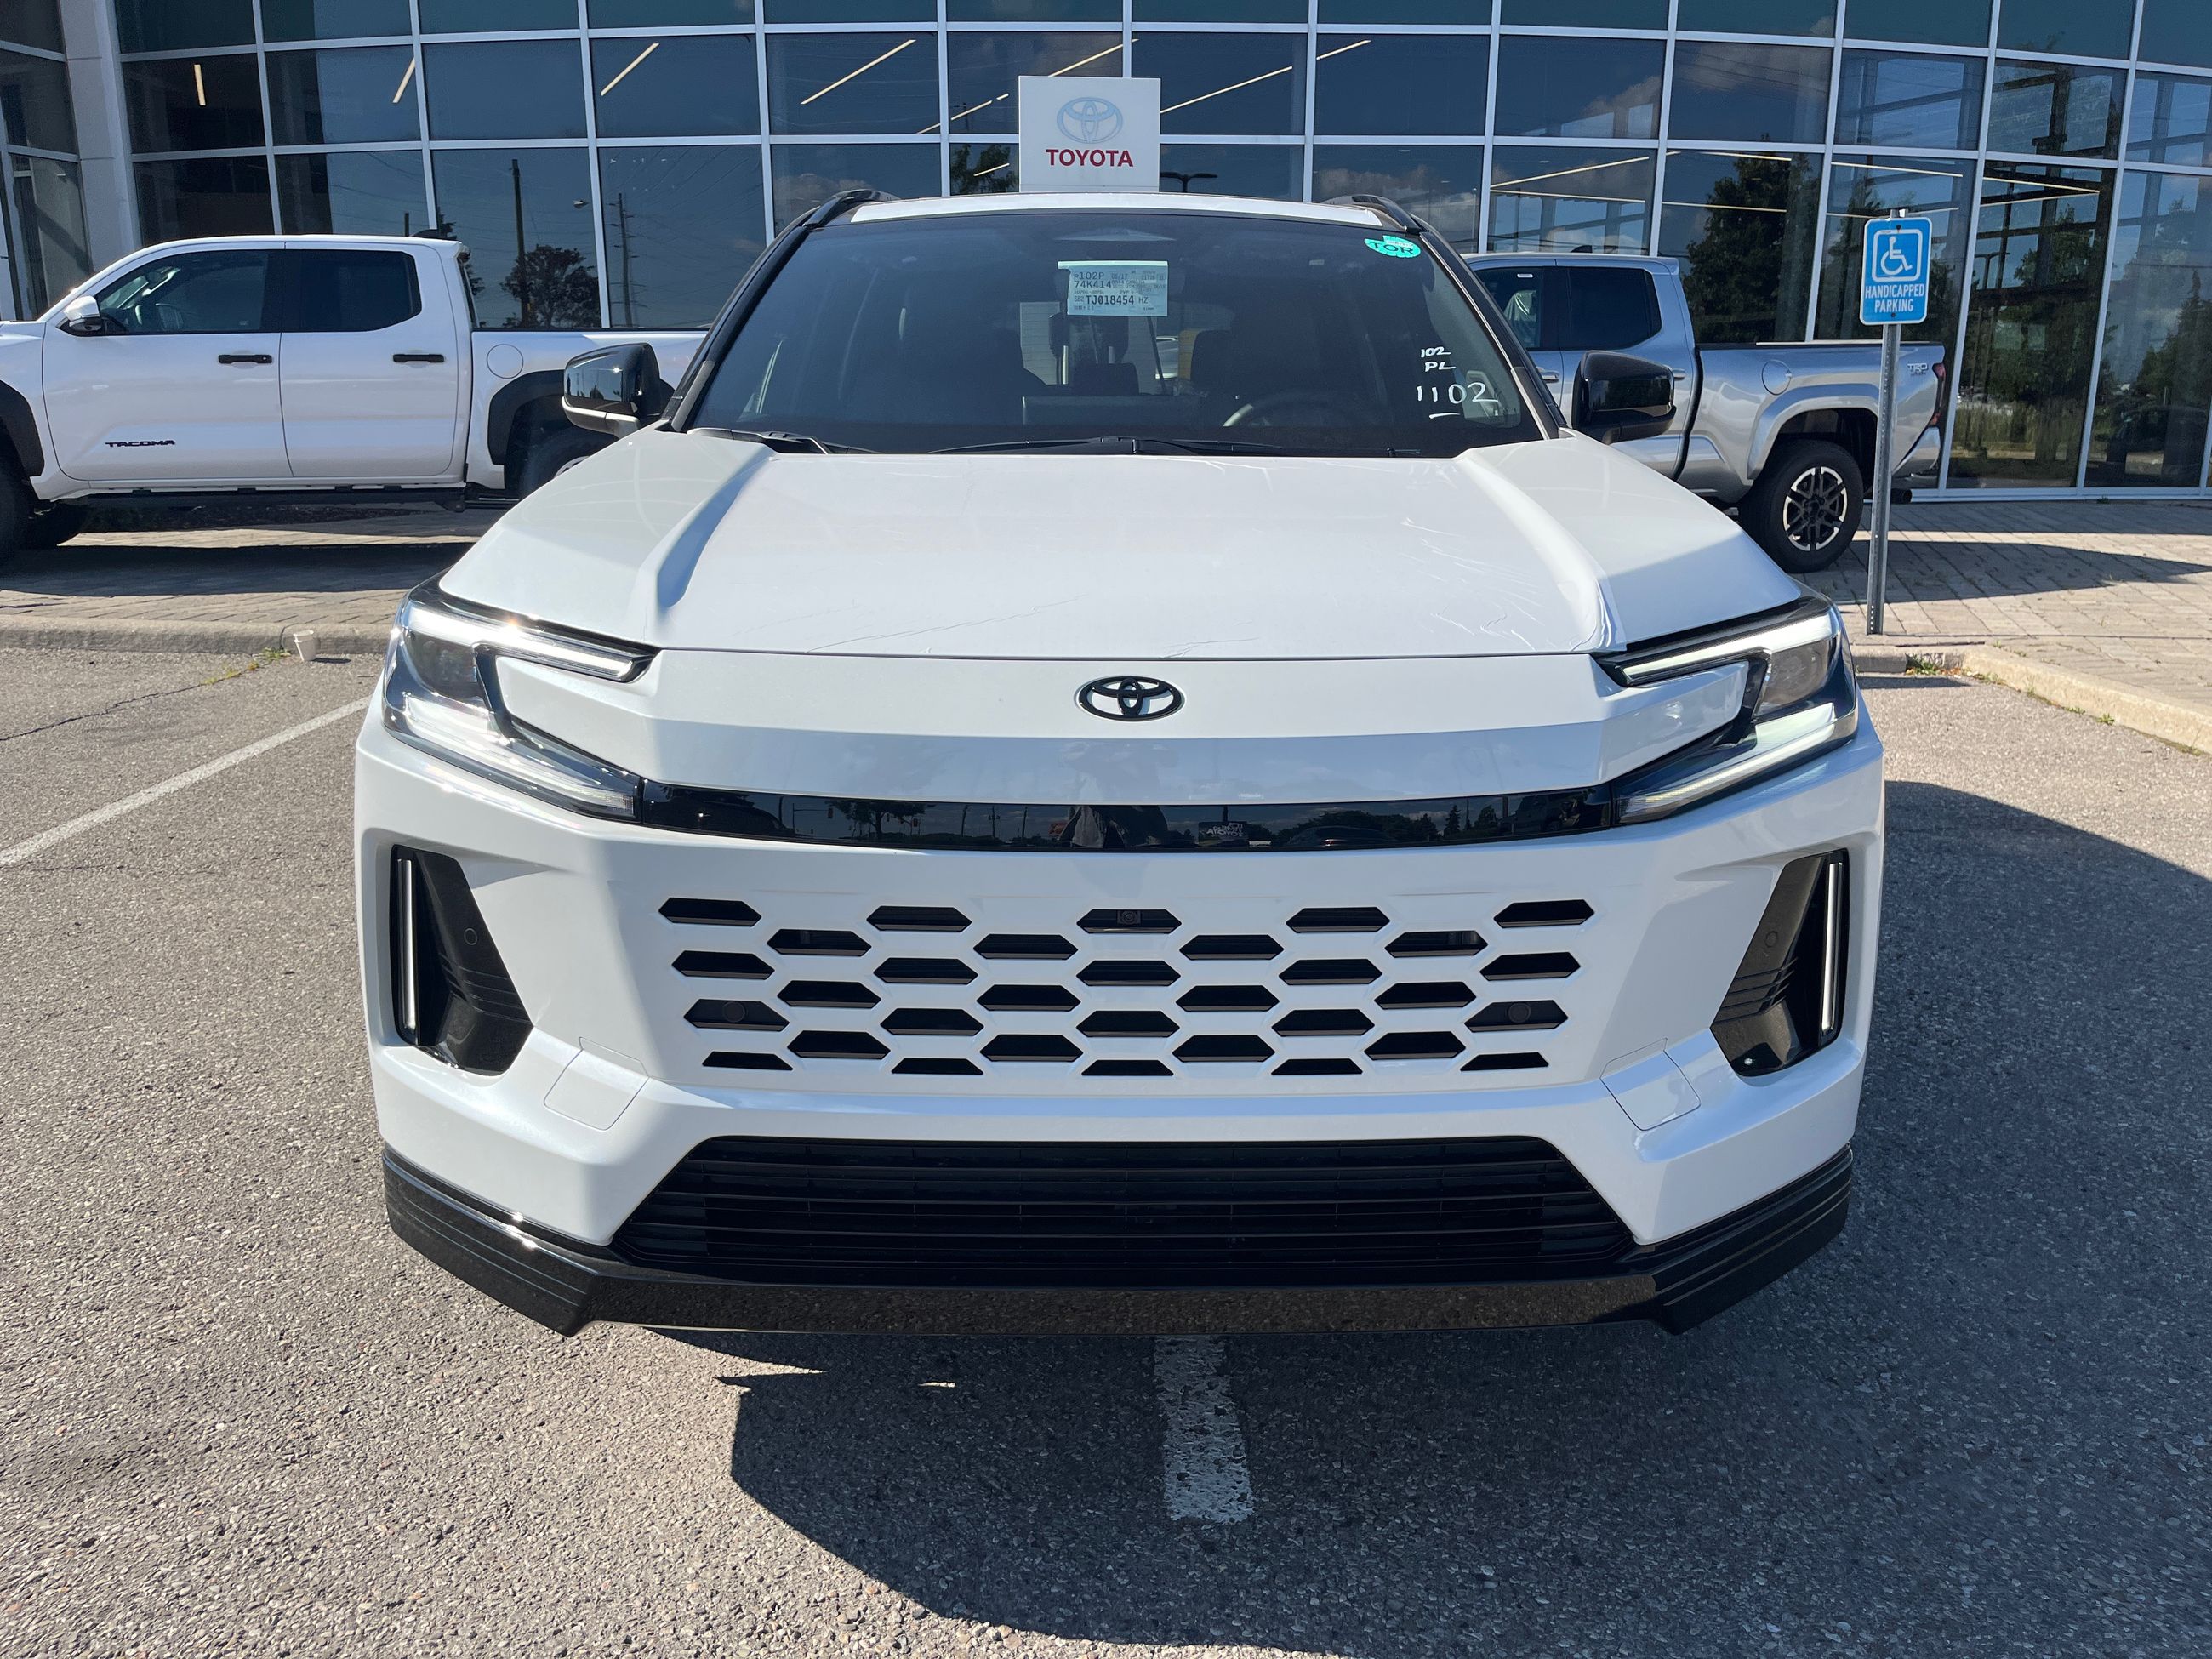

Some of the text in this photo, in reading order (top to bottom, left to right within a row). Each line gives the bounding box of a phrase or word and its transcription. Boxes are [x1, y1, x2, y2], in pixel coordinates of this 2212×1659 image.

[1046, 149, 1134, 167] TOYOTA
[1370, 242, 1415, 255] TOR
[1075, 280, 1112, 288] 74K414
[1865, 283, 1925, 299] HANDICAPPED
[1086, 295, 1134, 305] TJ018454
[1874, 299, 1914, 313] PARKING
[1420, 346, 1451, 358] 102
[1424, 361, 1457, 372] PL
[1417, 382, 1499, 404] 1102
